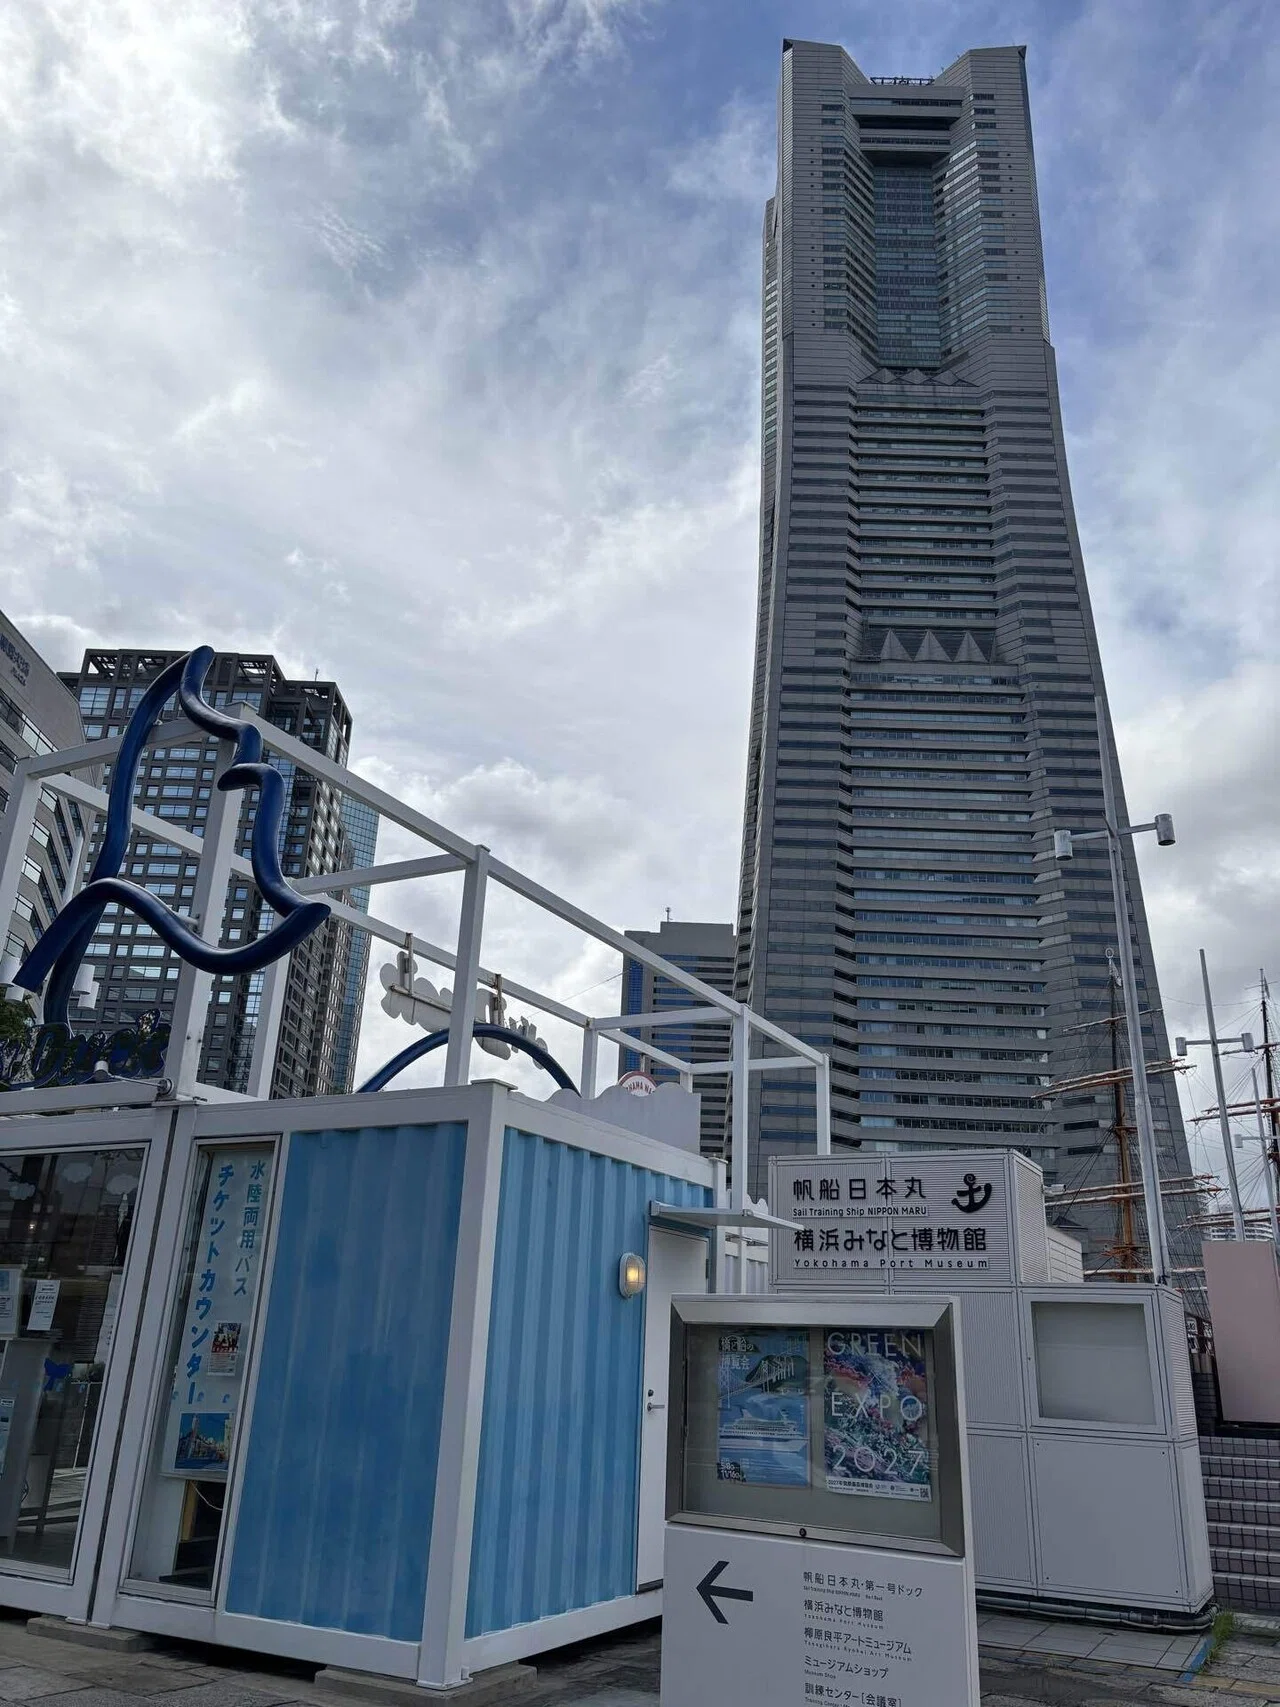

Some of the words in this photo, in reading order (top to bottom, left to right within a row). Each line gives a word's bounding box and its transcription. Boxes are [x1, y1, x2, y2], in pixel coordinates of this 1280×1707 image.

[793, 1177, 926, 1201] 帆船日本丸
[793, 1208, 807, 1217] Sail
[810, 1207, 844, 1217] Training
[846, 1207, 865, 1217] Ship
[867, 1207, 899, 1216] NIPPON
[901, 1206, 927, 1216] MARU
[234, 1160, 266, 1296] 水陸両用バス
[794, 1228, 987, 1251] 横浜みなと博物館
[794, 1259, 869, 1268] Yokohama
[880, 1259, 913, 1268] Port
[924, 1259, 988, 1268] Museum
[827, 1331, 922, 1357] GREEN
[831, 1391, 923, 1421] EXPO
[832, 1444, 925, 1477] 2027
[804, 1599, 884, 1622] 横浜みなと博物館
[804, 1626, 912, 1655] 柳原良平アートミュージアム
[804, 1655, 889, 1679] ミュージアムショップ
